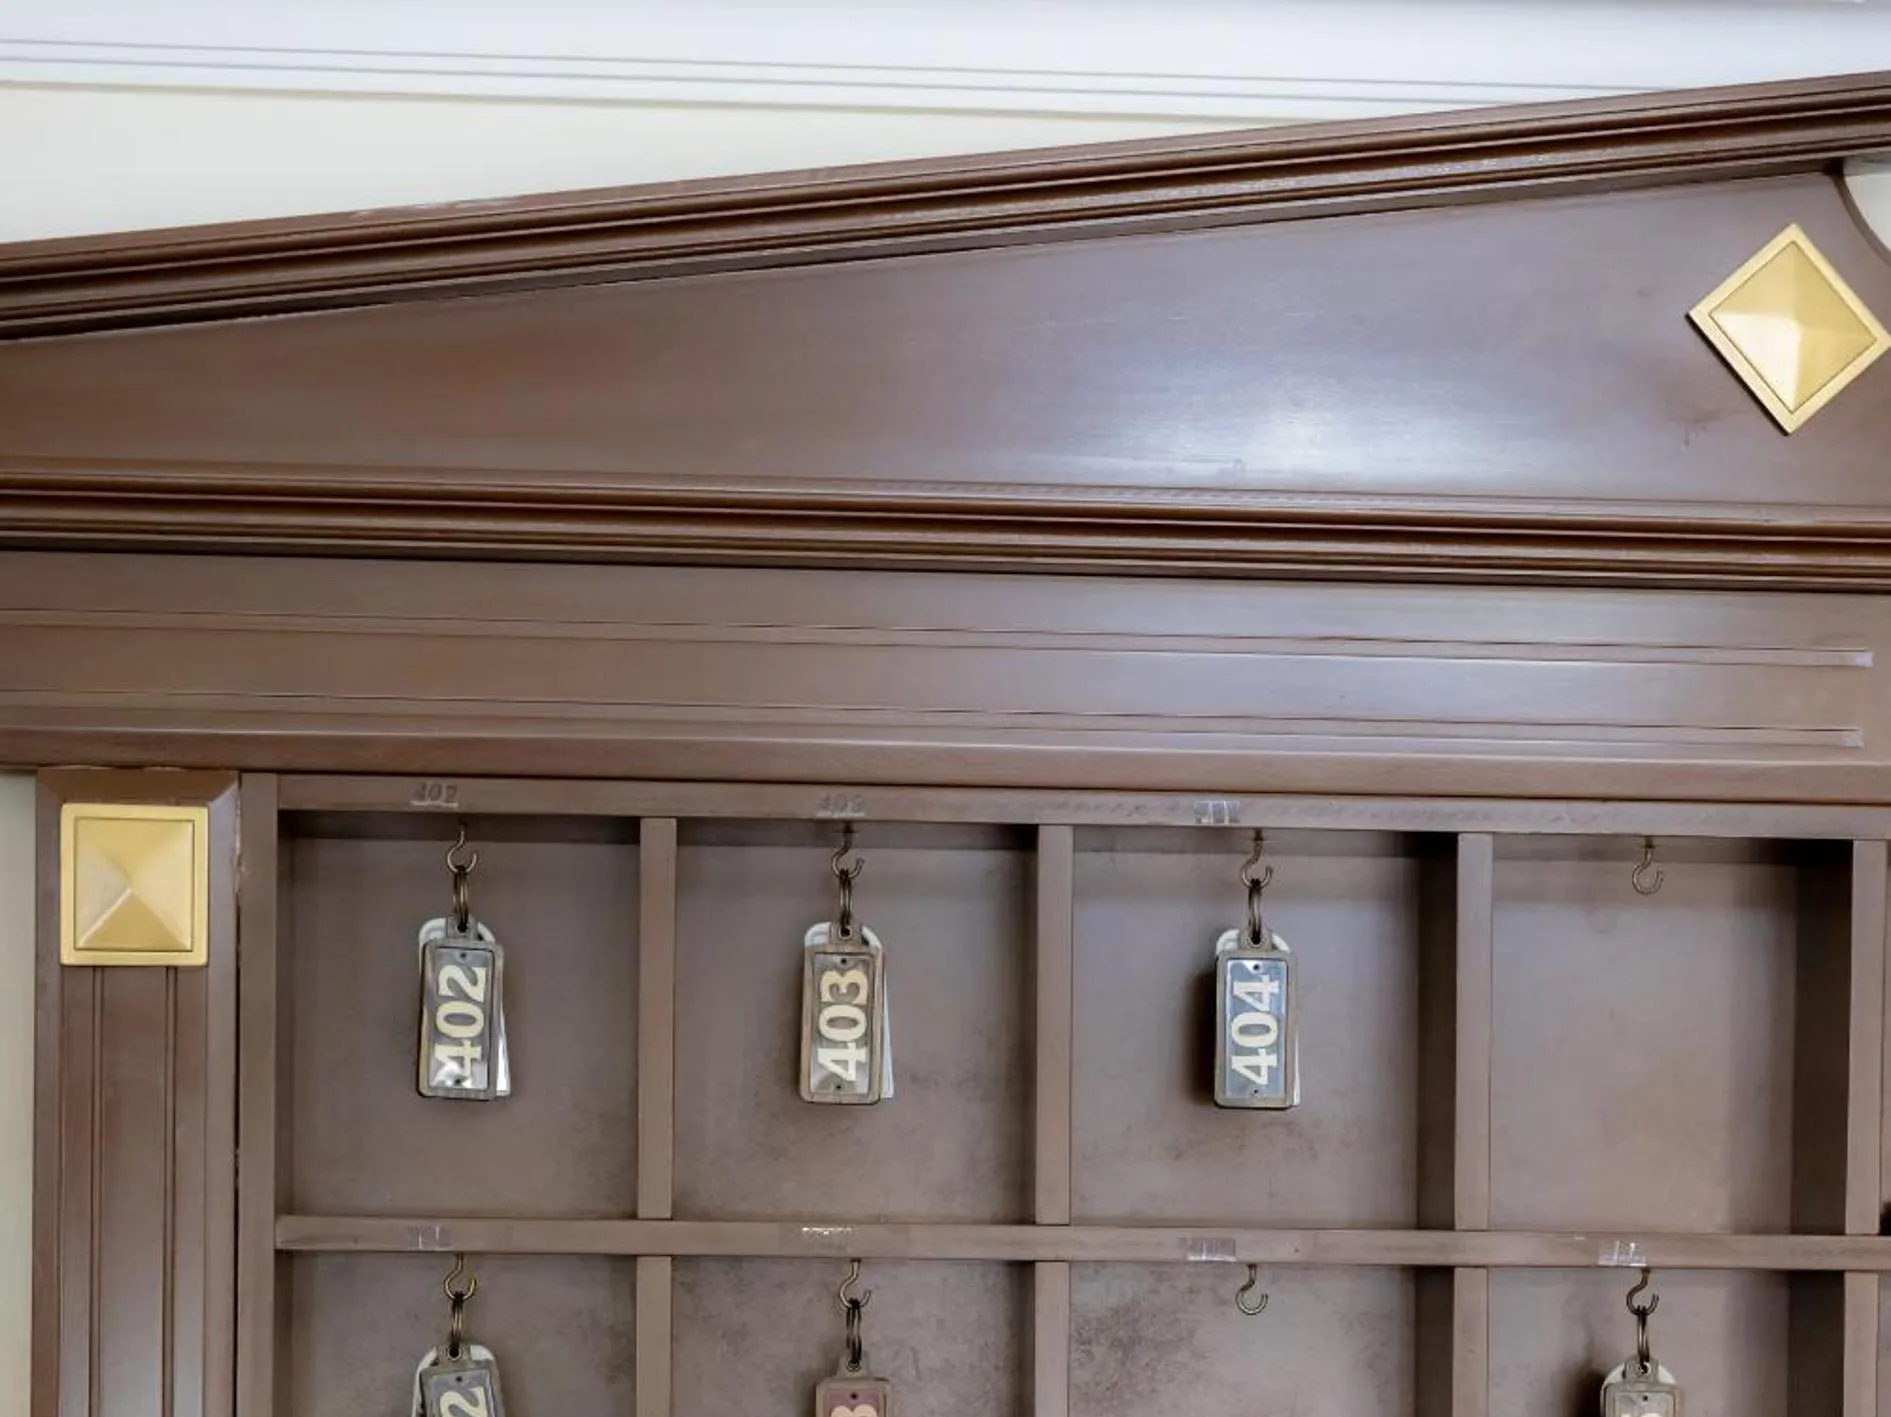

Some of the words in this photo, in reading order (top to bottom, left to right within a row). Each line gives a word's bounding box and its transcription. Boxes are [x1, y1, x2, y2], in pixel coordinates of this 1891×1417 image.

[435, 966, 487, 1080] 402
[819, 970, 869, 1083] 403
[1232, 976, 1279, 1085] 404
